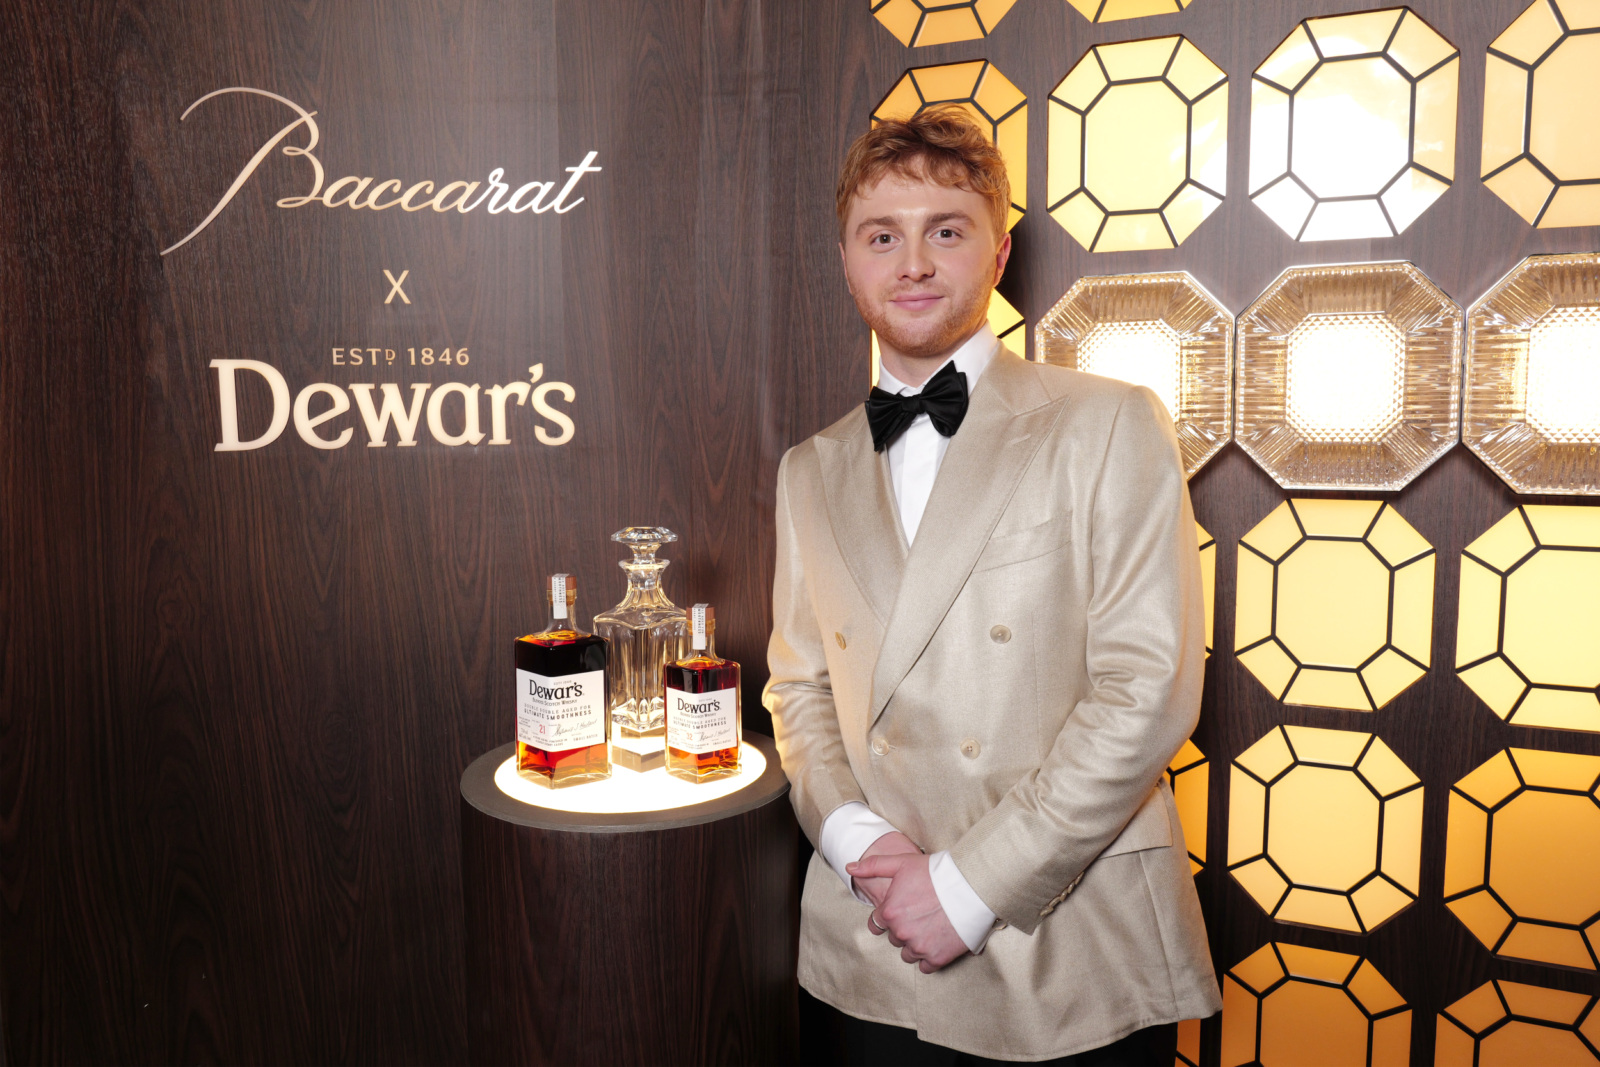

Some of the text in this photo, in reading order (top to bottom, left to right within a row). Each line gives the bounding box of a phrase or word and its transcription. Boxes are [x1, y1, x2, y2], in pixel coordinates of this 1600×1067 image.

[160, 86, 602, 255] Baccarat
[407, 347, 470, 365] 1846
[209, 359, 576, 452] Dewar's
[529, 679, 583, 700] Dewar's
[524, 708, 592, 720] ULTIMATE SMOOTHNESS
[677, 697, 720, 714] Dewar's
[539, 724, 546, 735] 21
